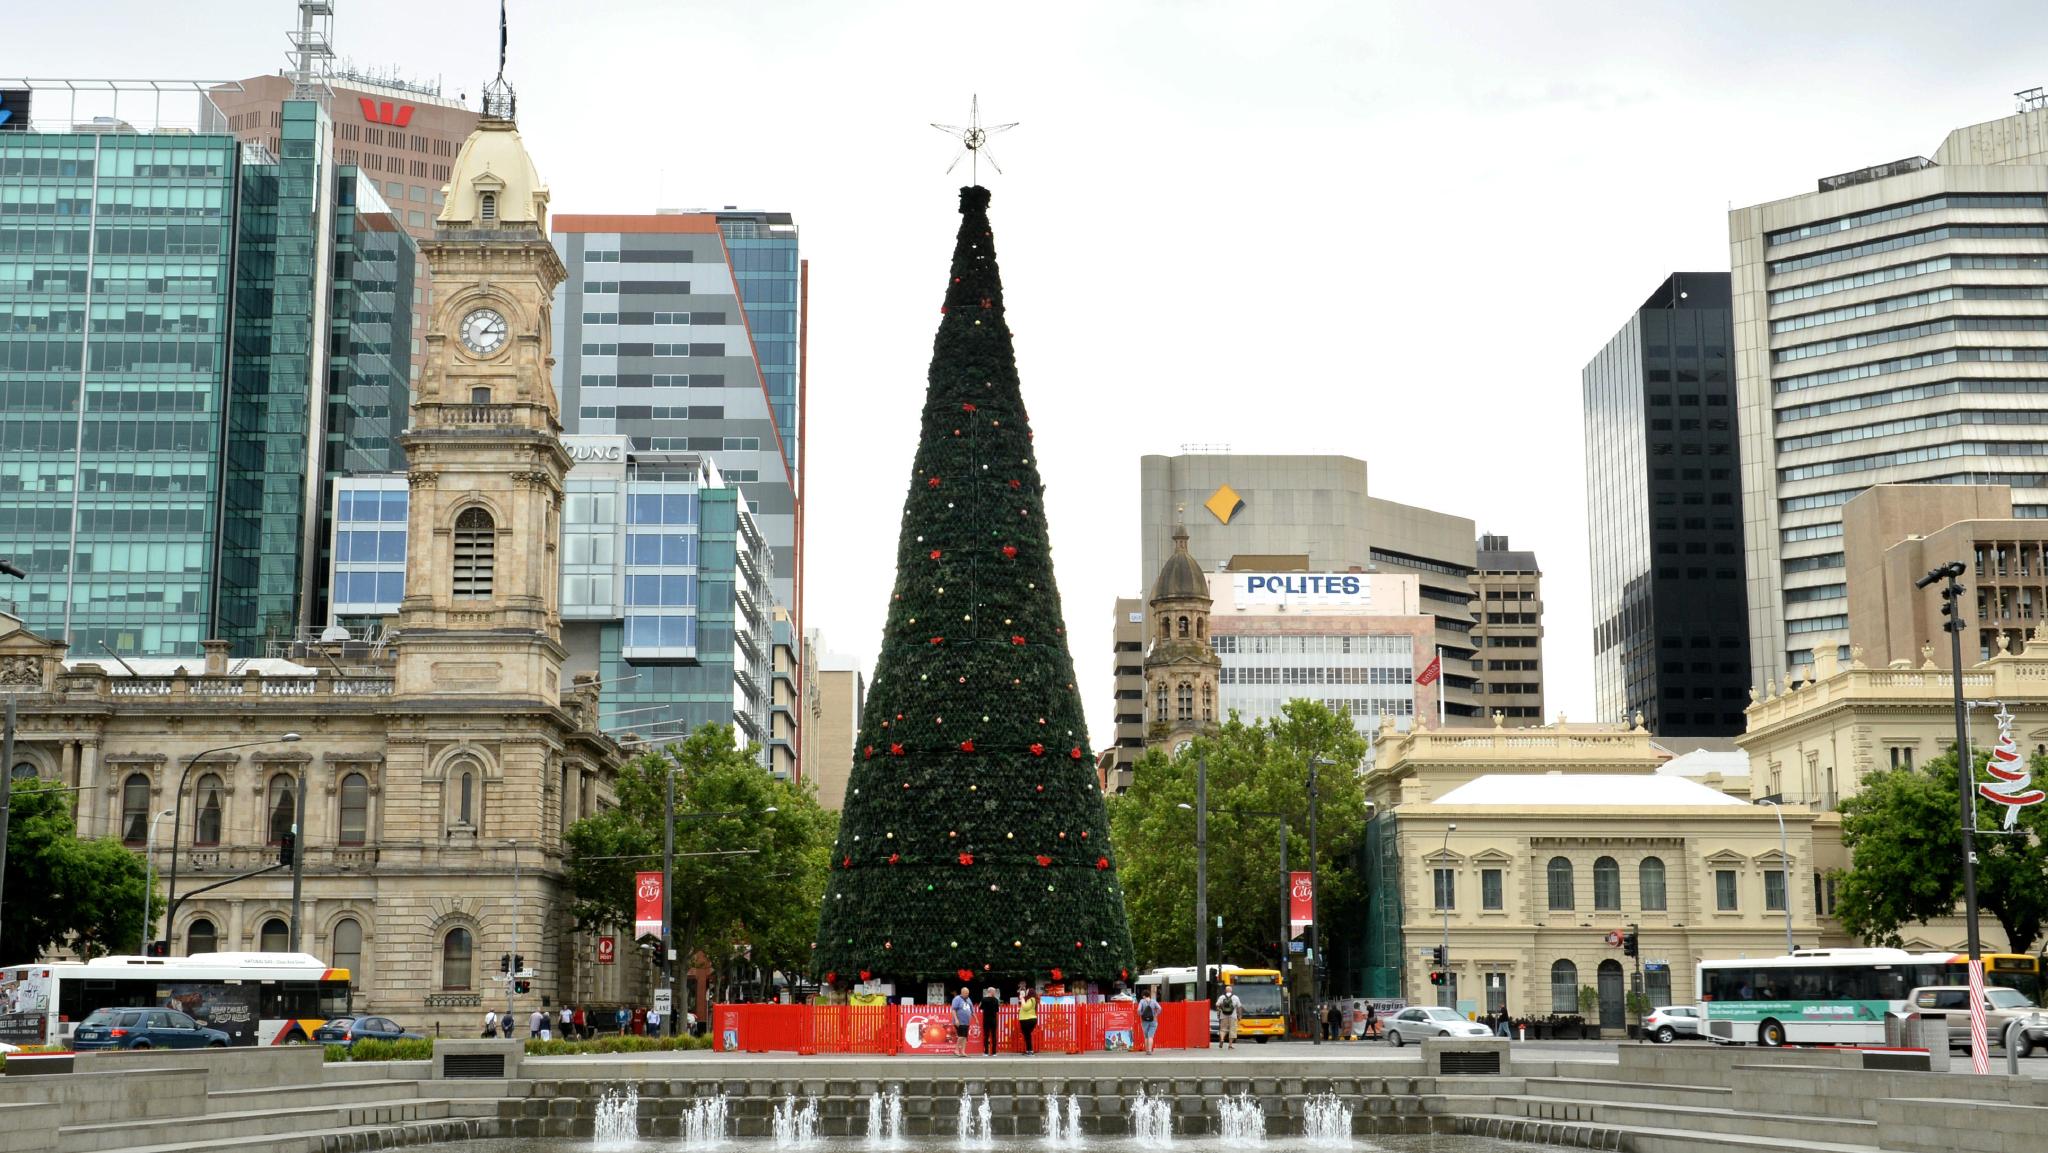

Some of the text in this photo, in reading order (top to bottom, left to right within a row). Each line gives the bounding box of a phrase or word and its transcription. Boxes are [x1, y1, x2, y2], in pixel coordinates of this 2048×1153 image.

[566, 446, 619, 461] OUNG
[1247, 575, 1360, 595] POLITES
[638, 885, 660, 902] City
[1292, 884, 1313, 902] City
[655, 1004, 670, 1012] LANE
